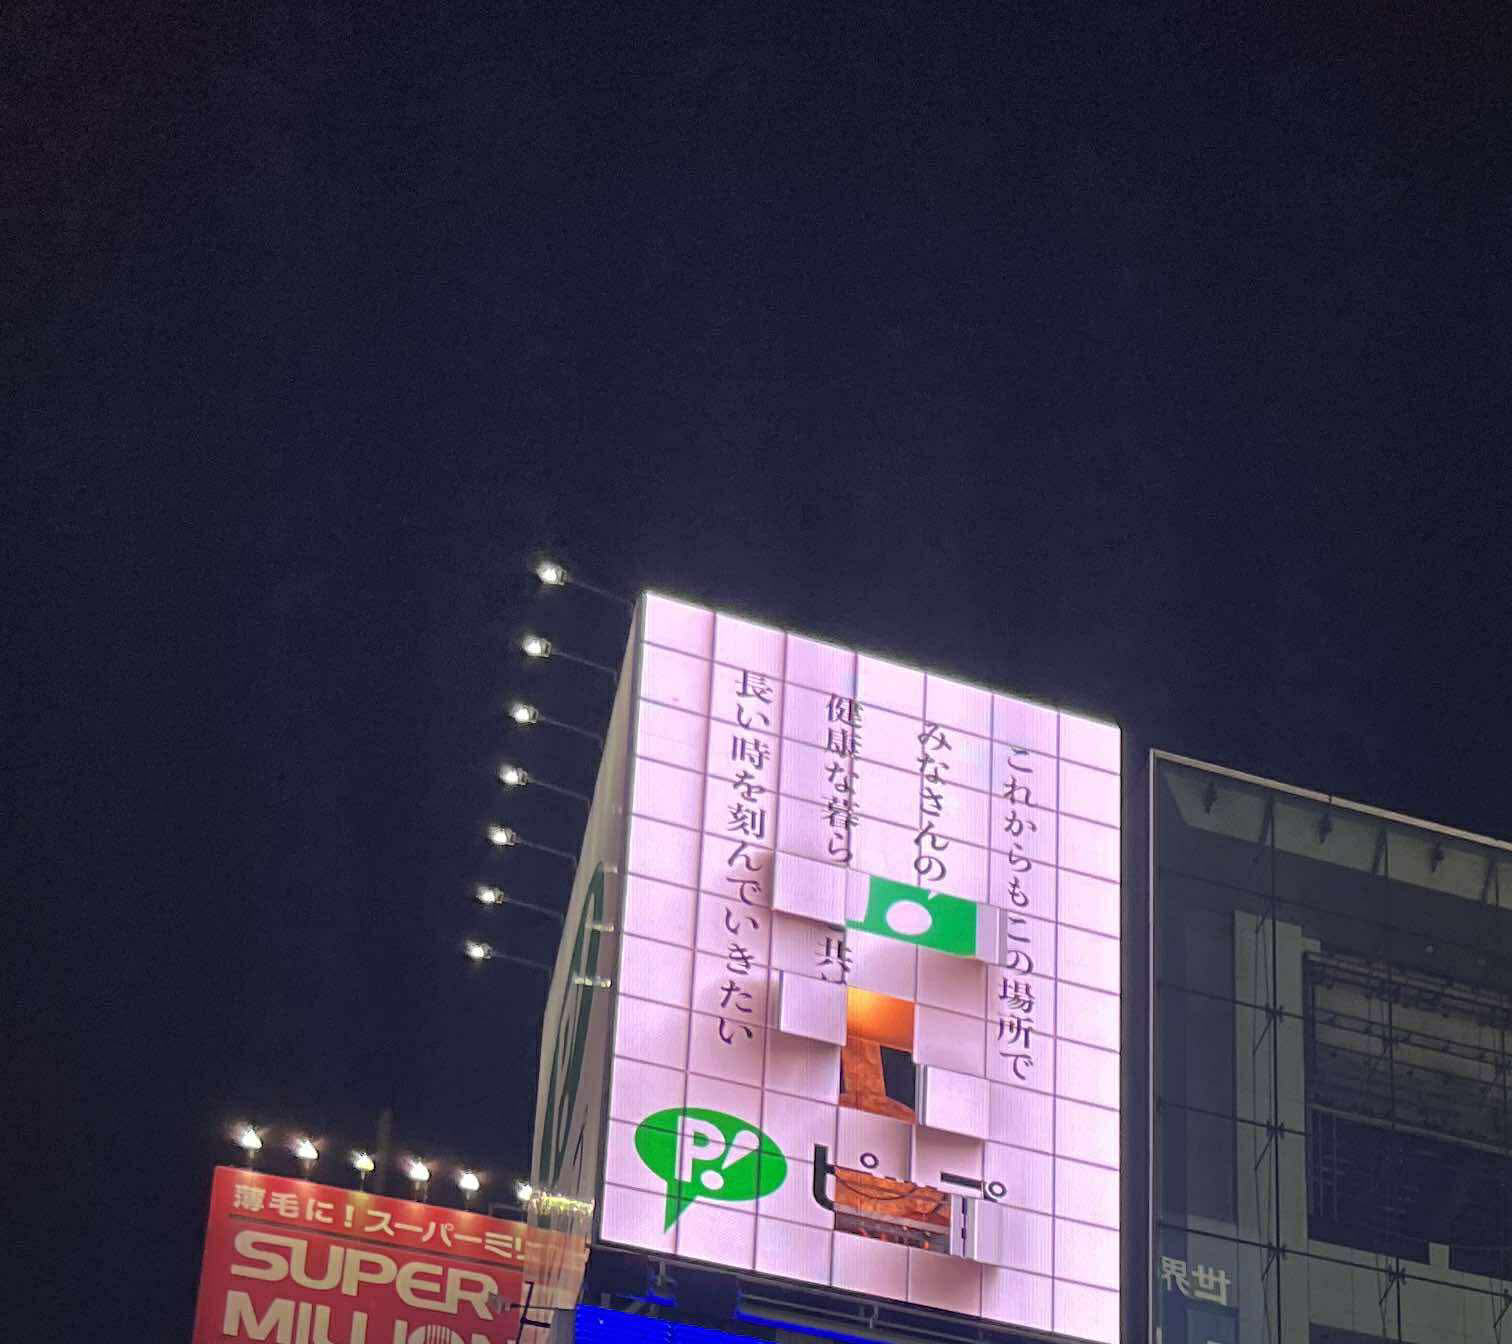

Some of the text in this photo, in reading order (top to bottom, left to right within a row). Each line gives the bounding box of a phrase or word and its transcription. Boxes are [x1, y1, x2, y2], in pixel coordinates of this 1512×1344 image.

[718, 670, 773, 1045] 長い時を刻んでいきたい
[911, 721, 953, 881] みなさんの
[997, 747, 1039, 1082] これからもこの場所で
[230, 1230, 498, 1321] SUPER
